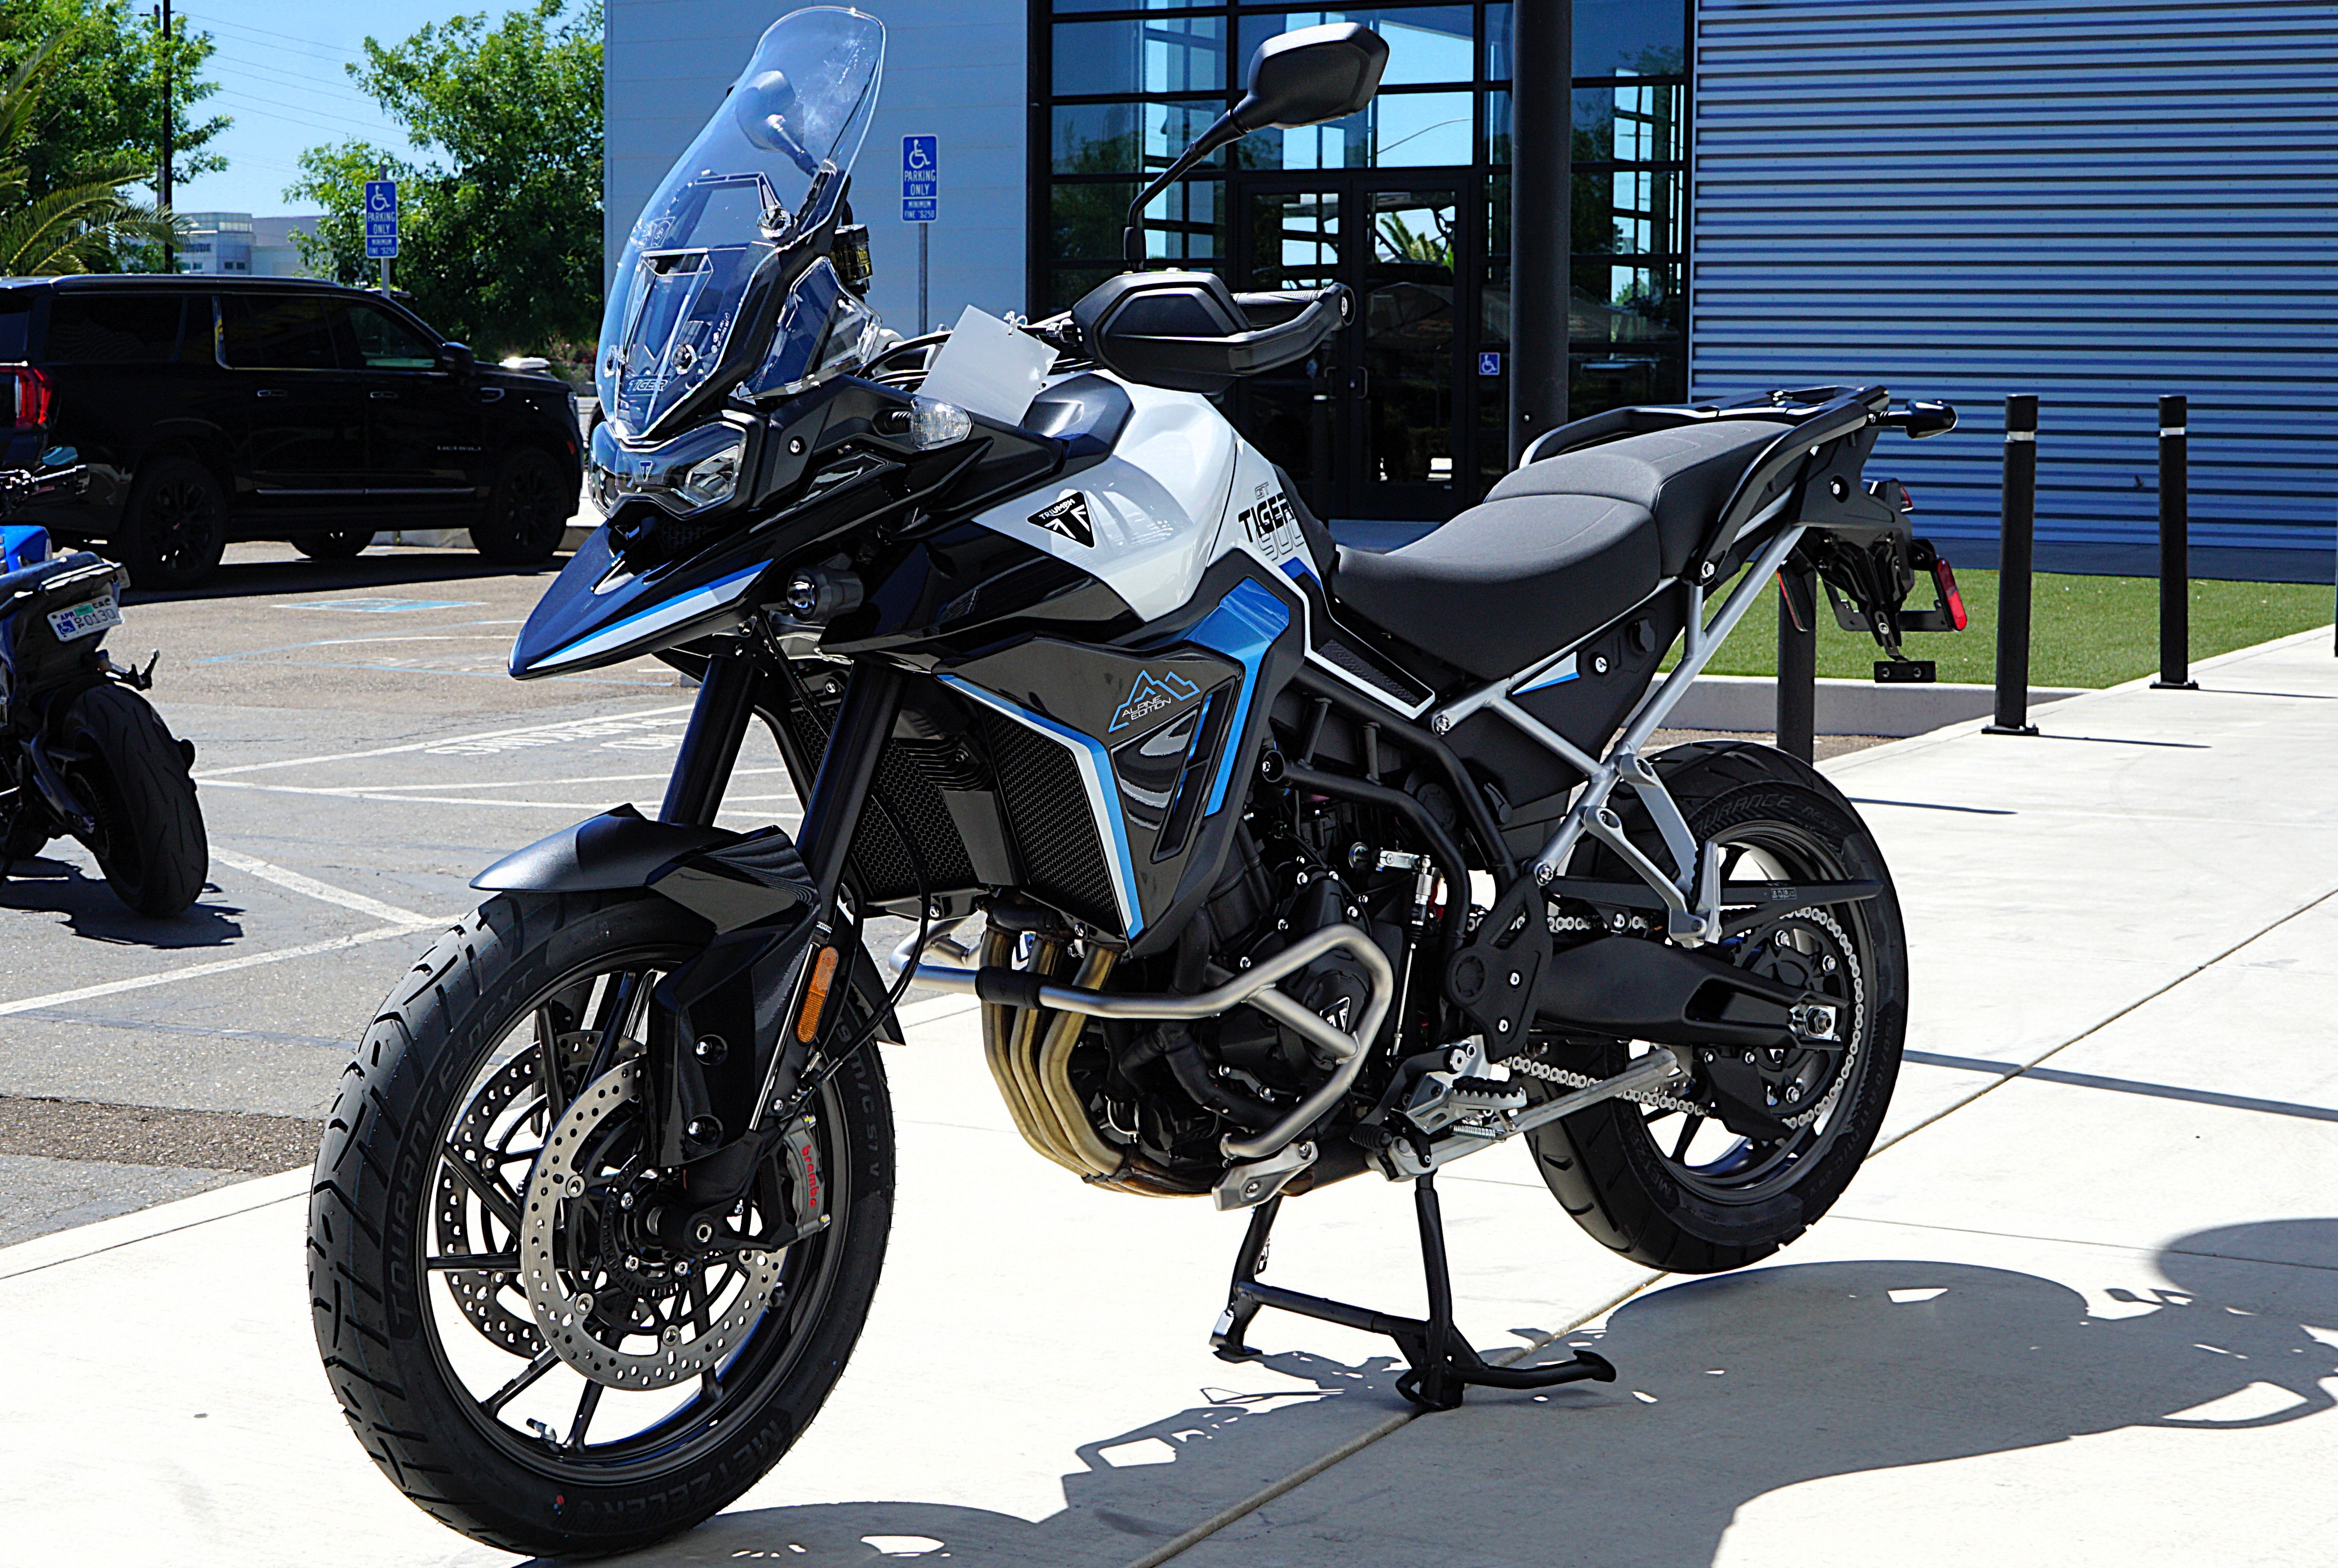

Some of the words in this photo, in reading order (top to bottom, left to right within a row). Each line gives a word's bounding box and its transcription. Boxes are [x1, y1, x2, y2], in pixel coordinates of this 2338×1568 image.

[905, 169, 936, 182] PARKING
[910, 184, 929, 196] ONLY
[368, 212, 395, 222] PARKING
[905, 210, 915, 218] FINE
[373, 224, 390, 235] ONLY
[627, 379, 668, 392] TIGER
[1254, 482, 1269, 500] GT
[1038, 498, 1076, 519] TRIUMPH
[1238, 492, 1295, 543] TIGER
[60, 611, 76, 621] APR
[84, 608, 116, 626] 0130
[1122, 695, 1162, 718] ALPINE
[1131, 697, 1171, 720] EDITION
[1693, 794, 1796, 836] OURANCE
[802, 1145, 819, 1207] brembo
